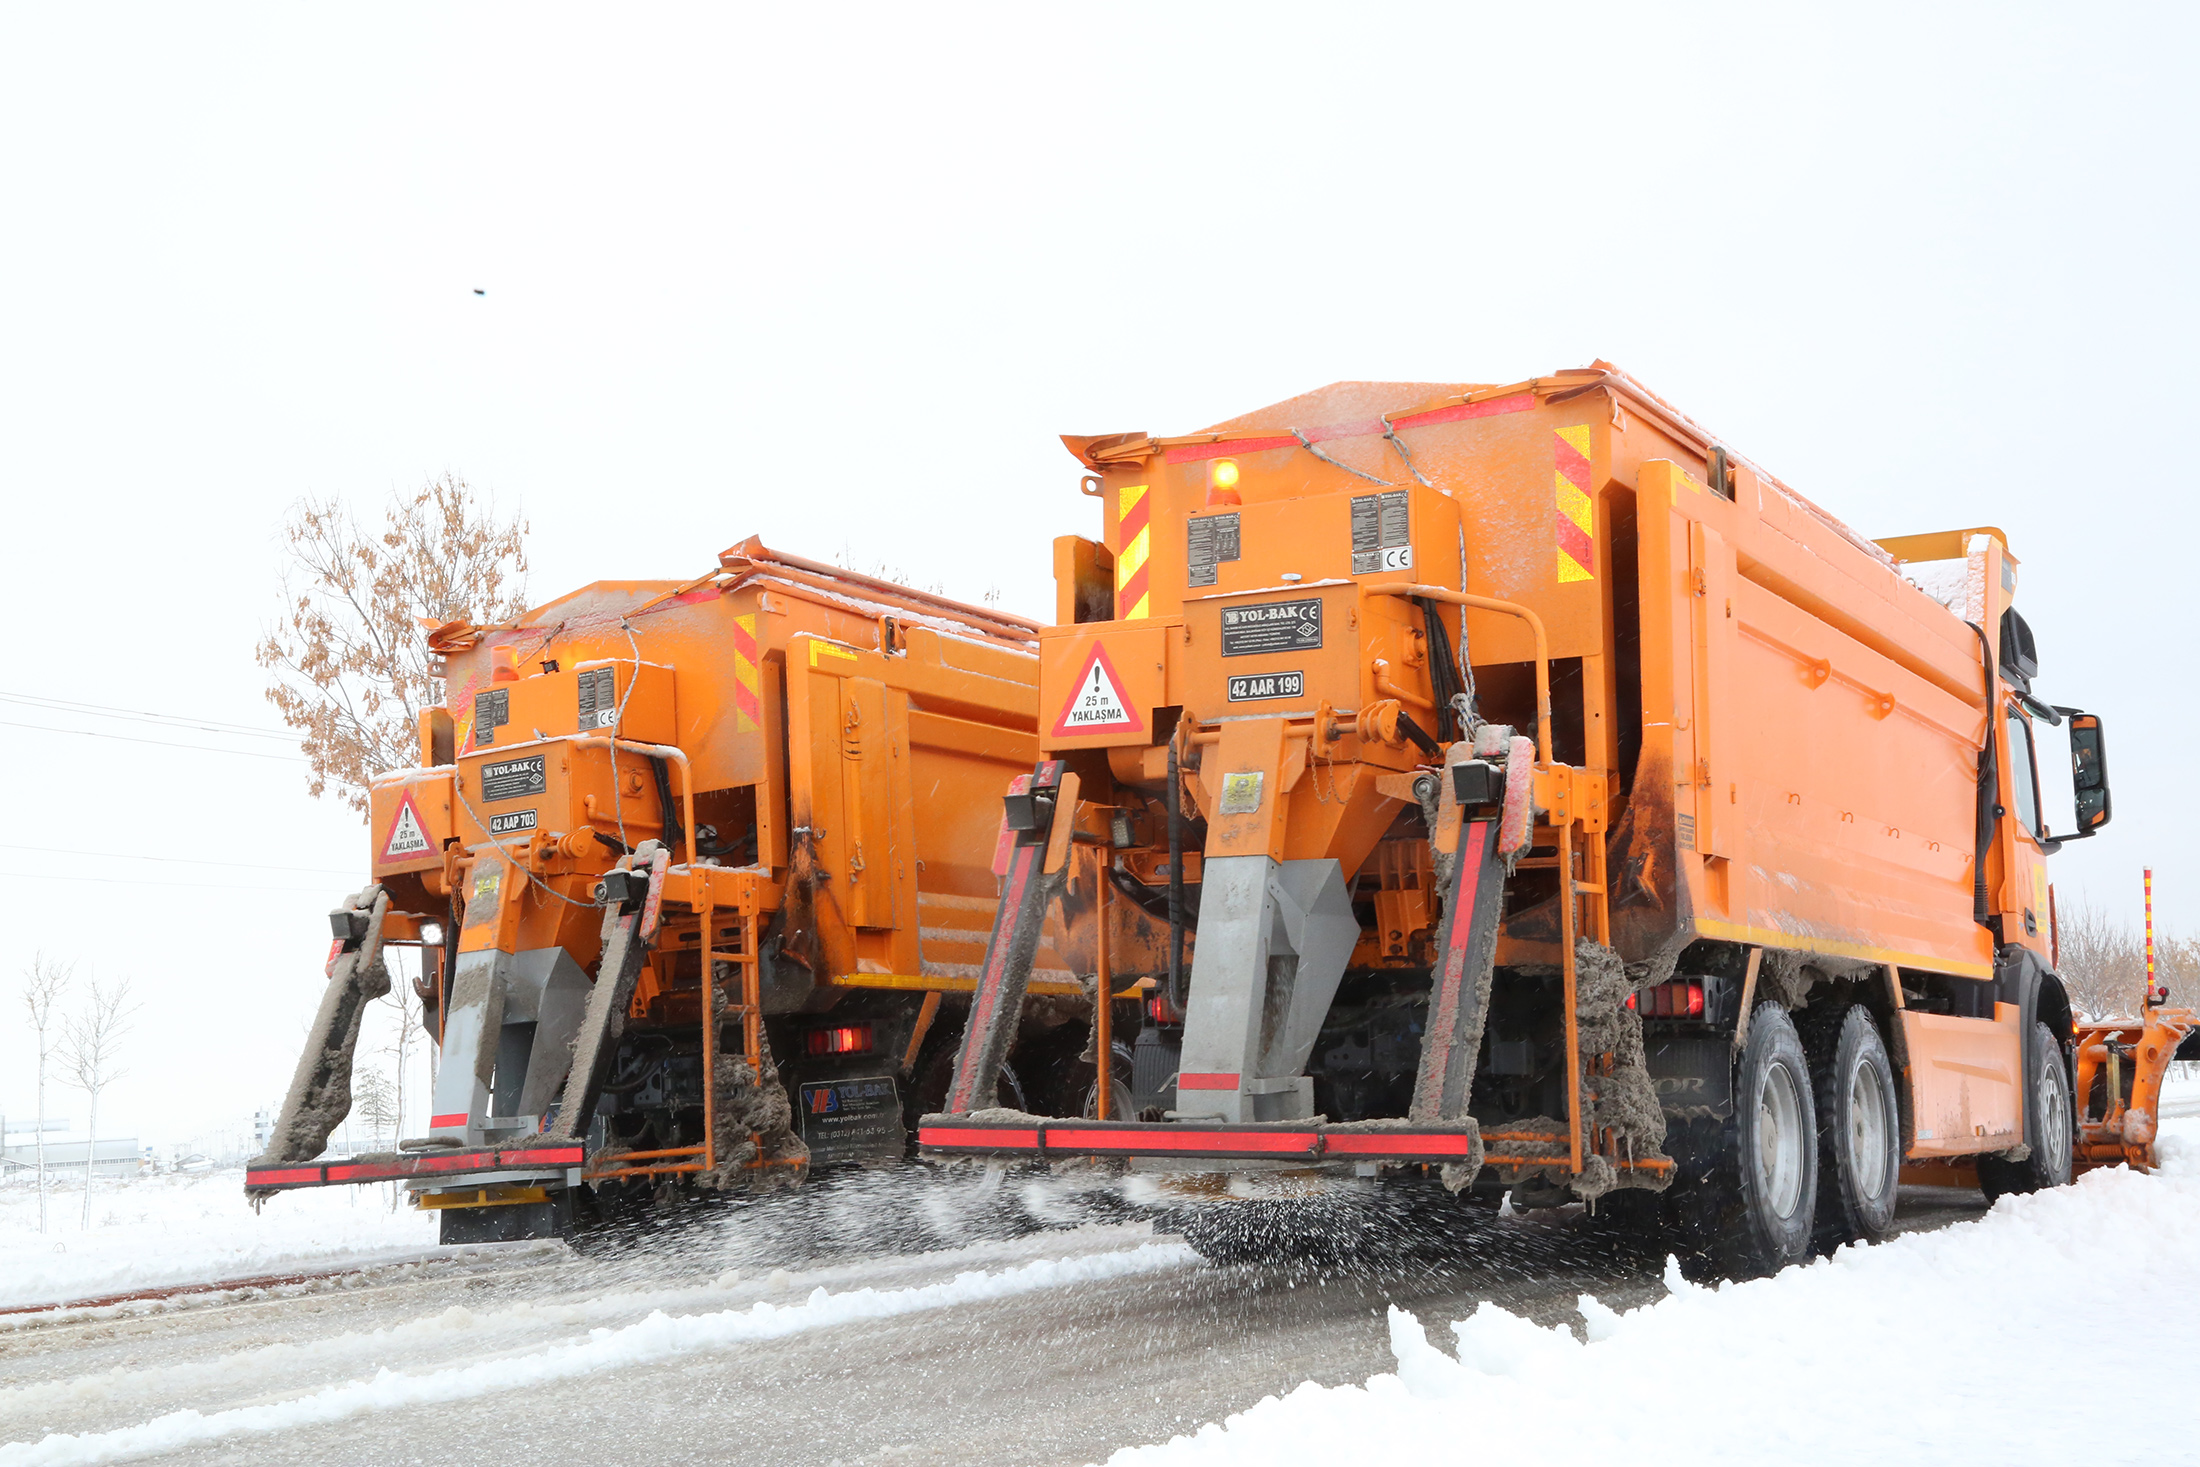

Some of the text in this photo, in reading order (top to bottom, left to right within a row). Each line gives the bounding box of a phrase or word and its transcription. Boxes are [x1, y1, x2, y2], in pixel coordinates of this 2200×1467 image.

[1239, 606, 1298, 622] YOL-BAK
[1232, 676, 1299, 697] 42 AAR 199
[1085, 695, 1109, 706] 25 m
[1072, 708, 1122, 723] YAKLAŞMA
[493, 761, 530, 776] YOL-BAK
[492, 813, 535, 831] 42 AAP 703
[400, 831, 408, 839] 25
[391, 839, 424, 851] YAKLAŞMA
